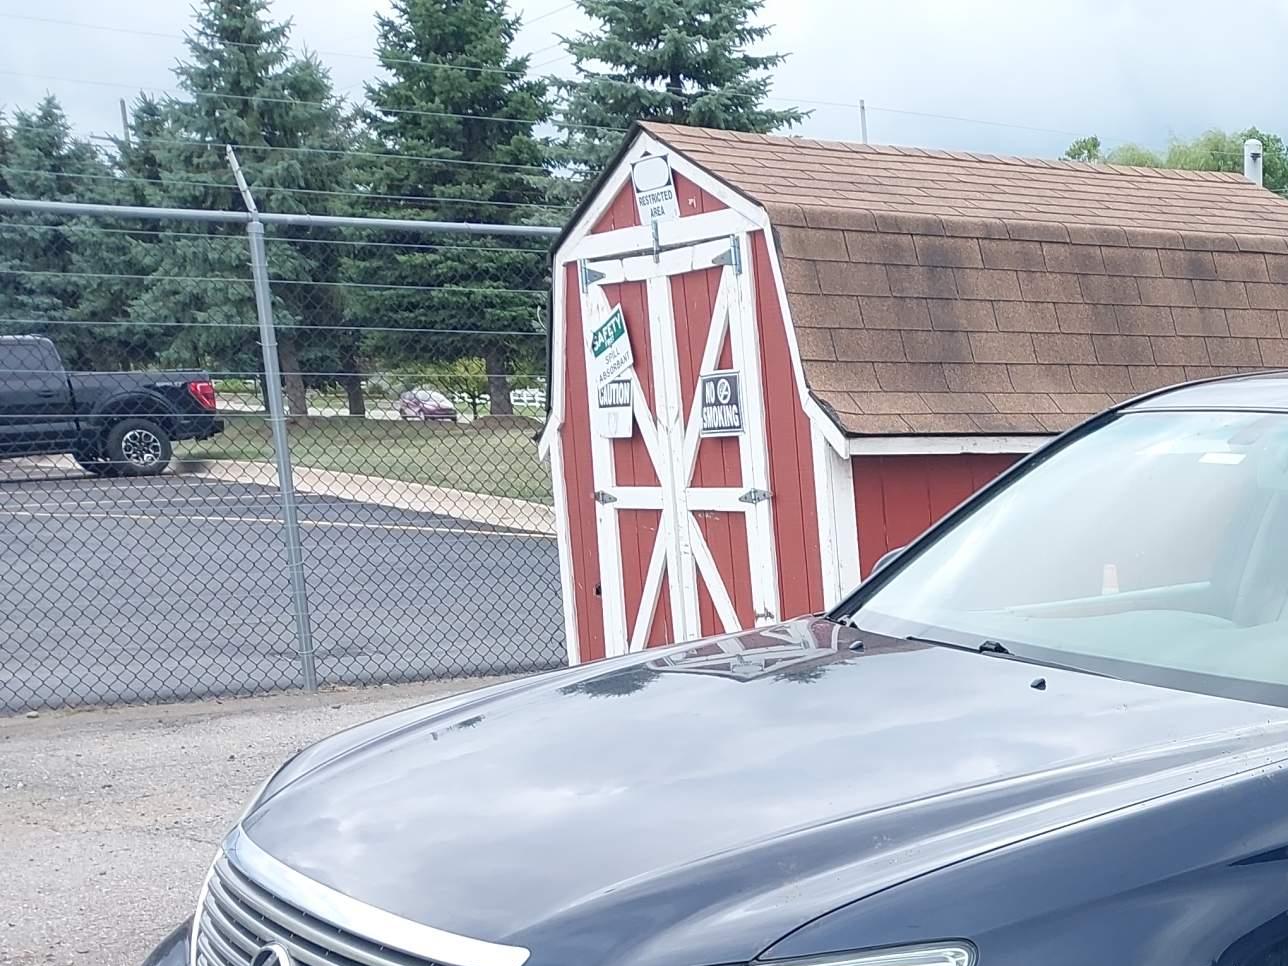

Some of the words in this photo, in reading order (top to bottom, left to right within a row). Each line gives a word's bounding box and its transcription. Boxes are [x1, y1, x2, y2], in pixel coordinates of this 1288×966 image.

[639, 190, 673, 206] RESTRICTED
[651, 206, 665, 217] AREA
[593, 312, 623, 352] SAFETY
[605, 347, 621, 364] SPILL
[600, 383, 630, 406] CAUTION
[705, 381, 715, 404] NO
[703, 404, 740, 429] SMOKING
